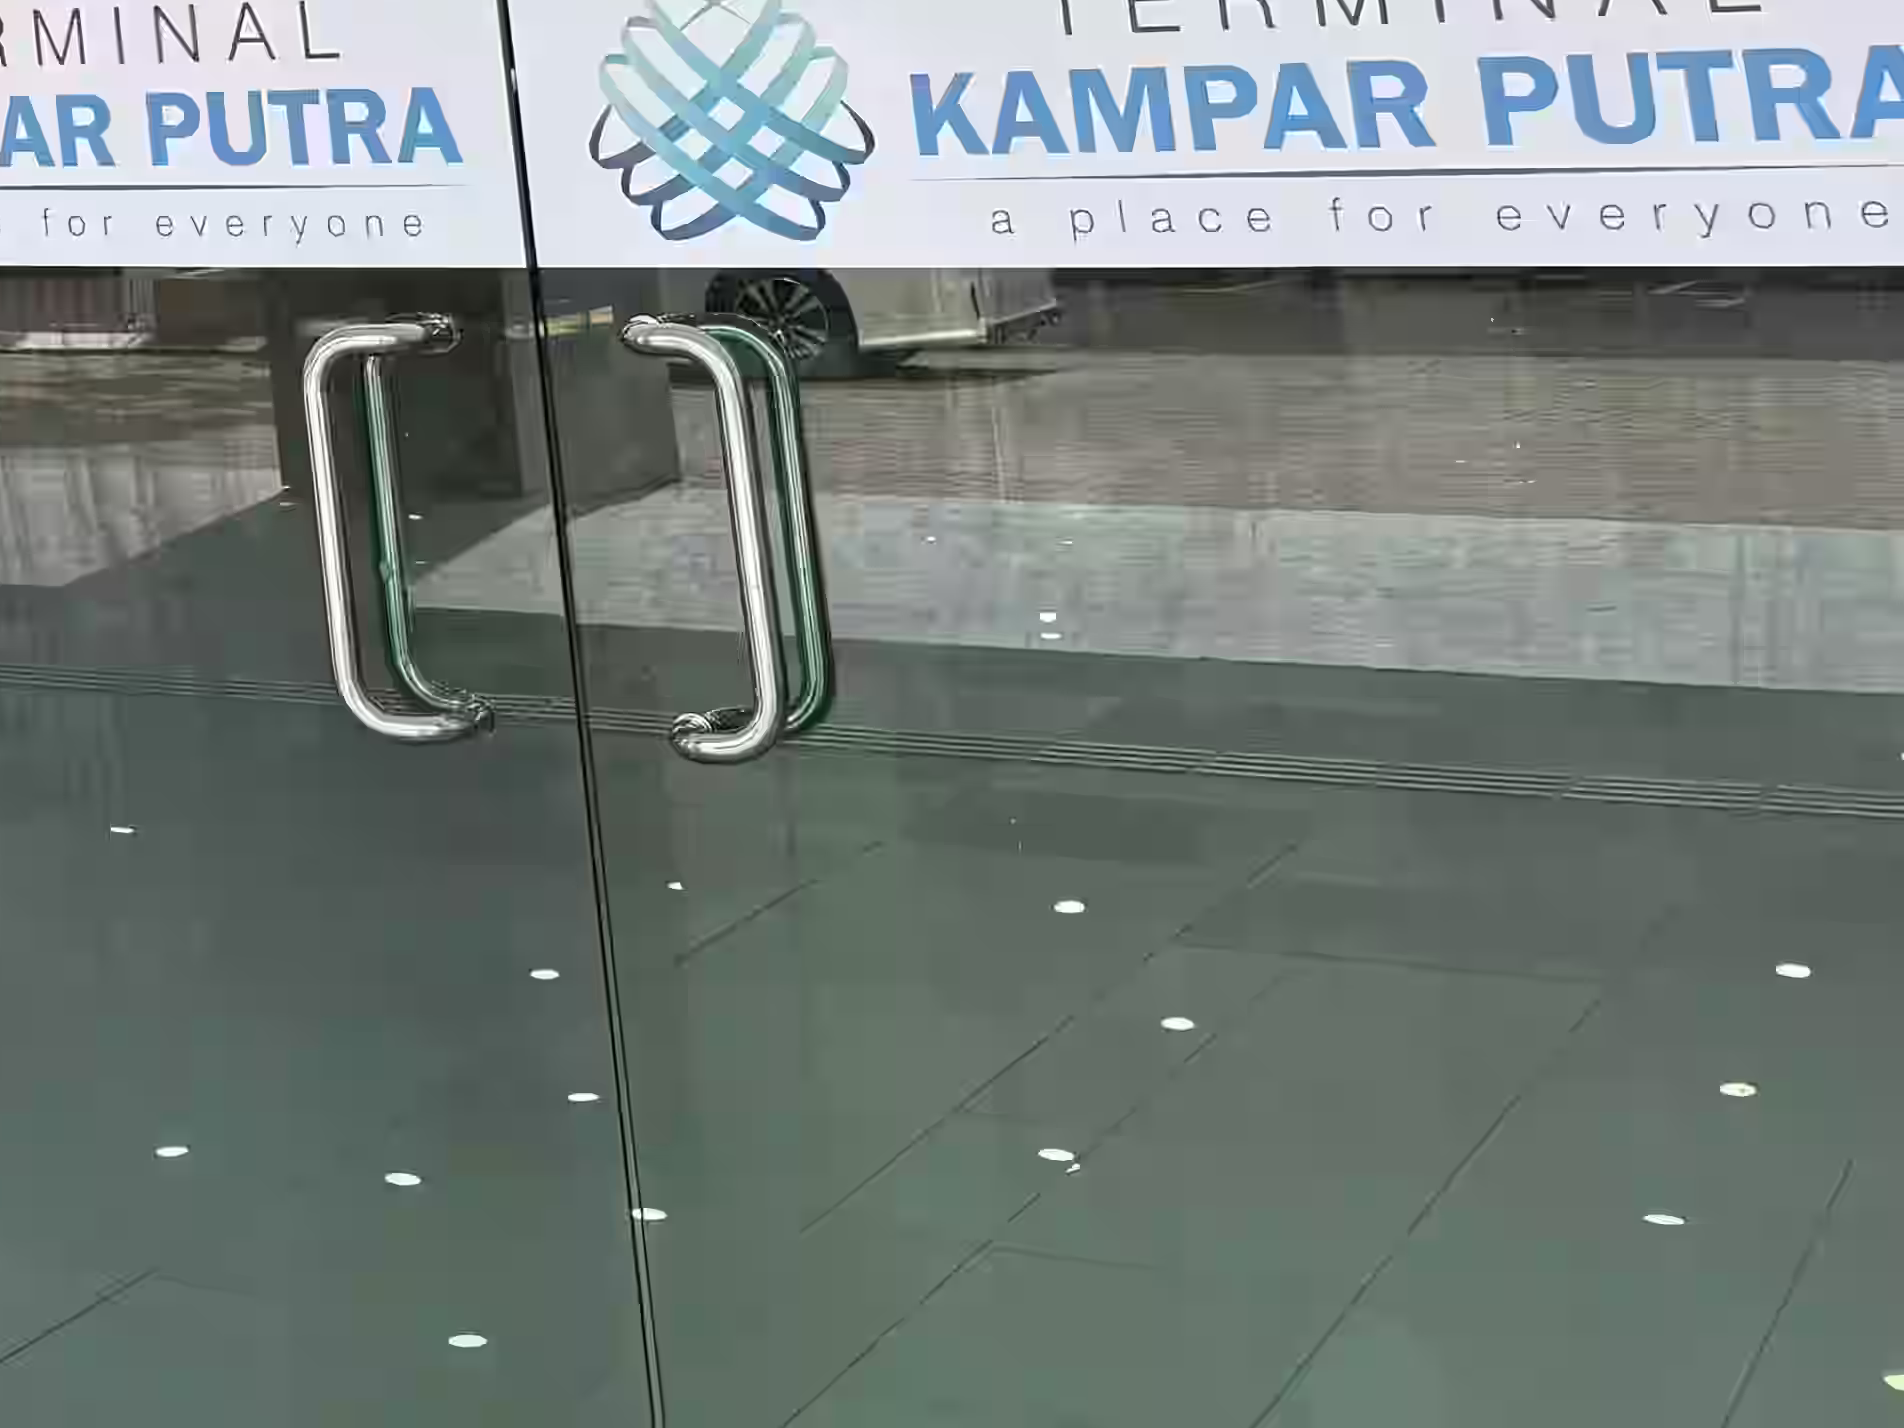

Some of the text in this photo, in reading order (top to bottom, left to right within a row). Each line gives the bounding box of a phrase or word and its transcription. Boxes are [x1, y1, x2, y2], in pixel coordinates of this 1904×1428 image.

[144, 84, 464, 167] PUTRA
[909, 42, 1904, 157] KAMPAR PUTRA
[40, 206, 113, 237] for
[154, 208, 424, 247] everyone
[990, 190, 1889, 245] a place for everyone
